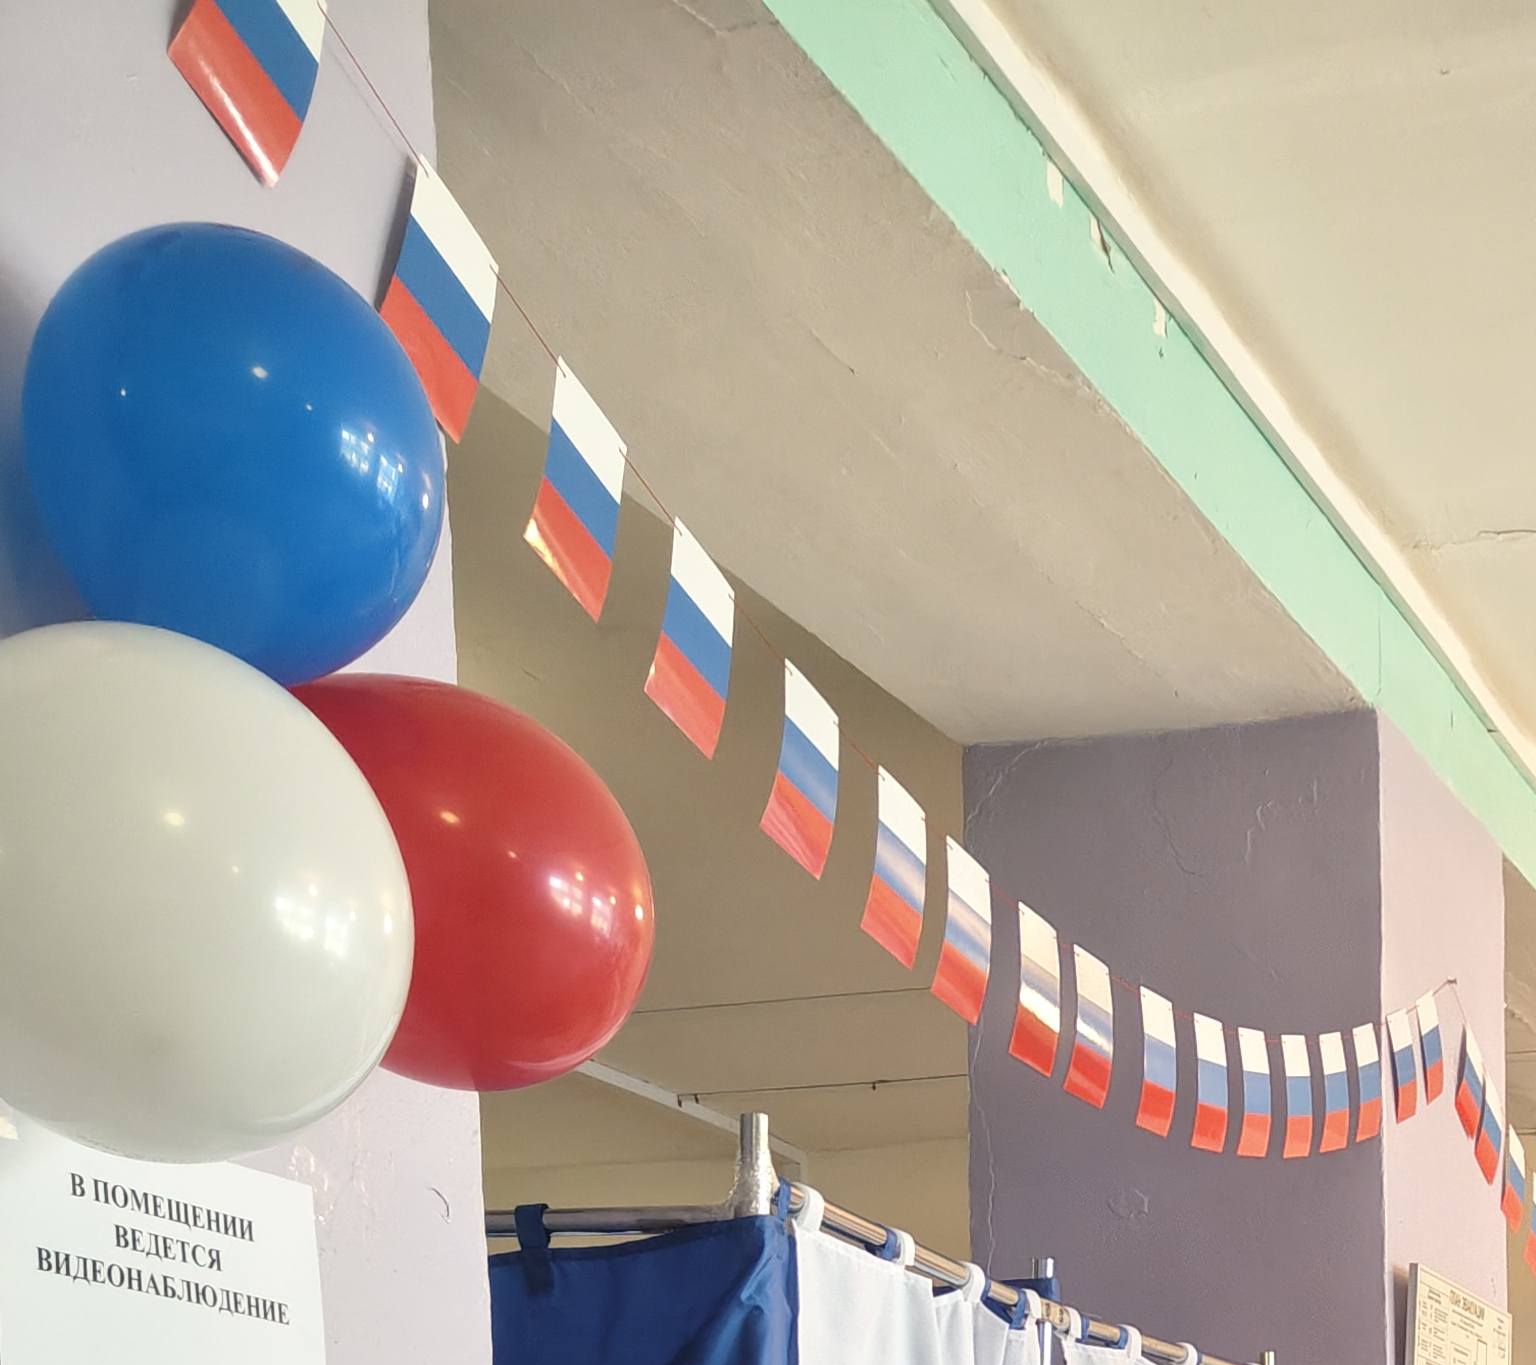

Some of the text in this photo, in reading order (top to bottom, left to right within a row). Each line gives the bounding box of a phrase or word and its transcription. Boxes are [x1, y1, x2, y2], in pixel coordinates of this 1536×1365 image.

[69, 1172, 255, 1243] В ПОМЕЩЕНИИ
[114, 1223, 223, 1272] ВЕДЕТСЯ
[36, 1246, 291, 1326] ВИДЕОНАБЛЮДЕНИЕ
